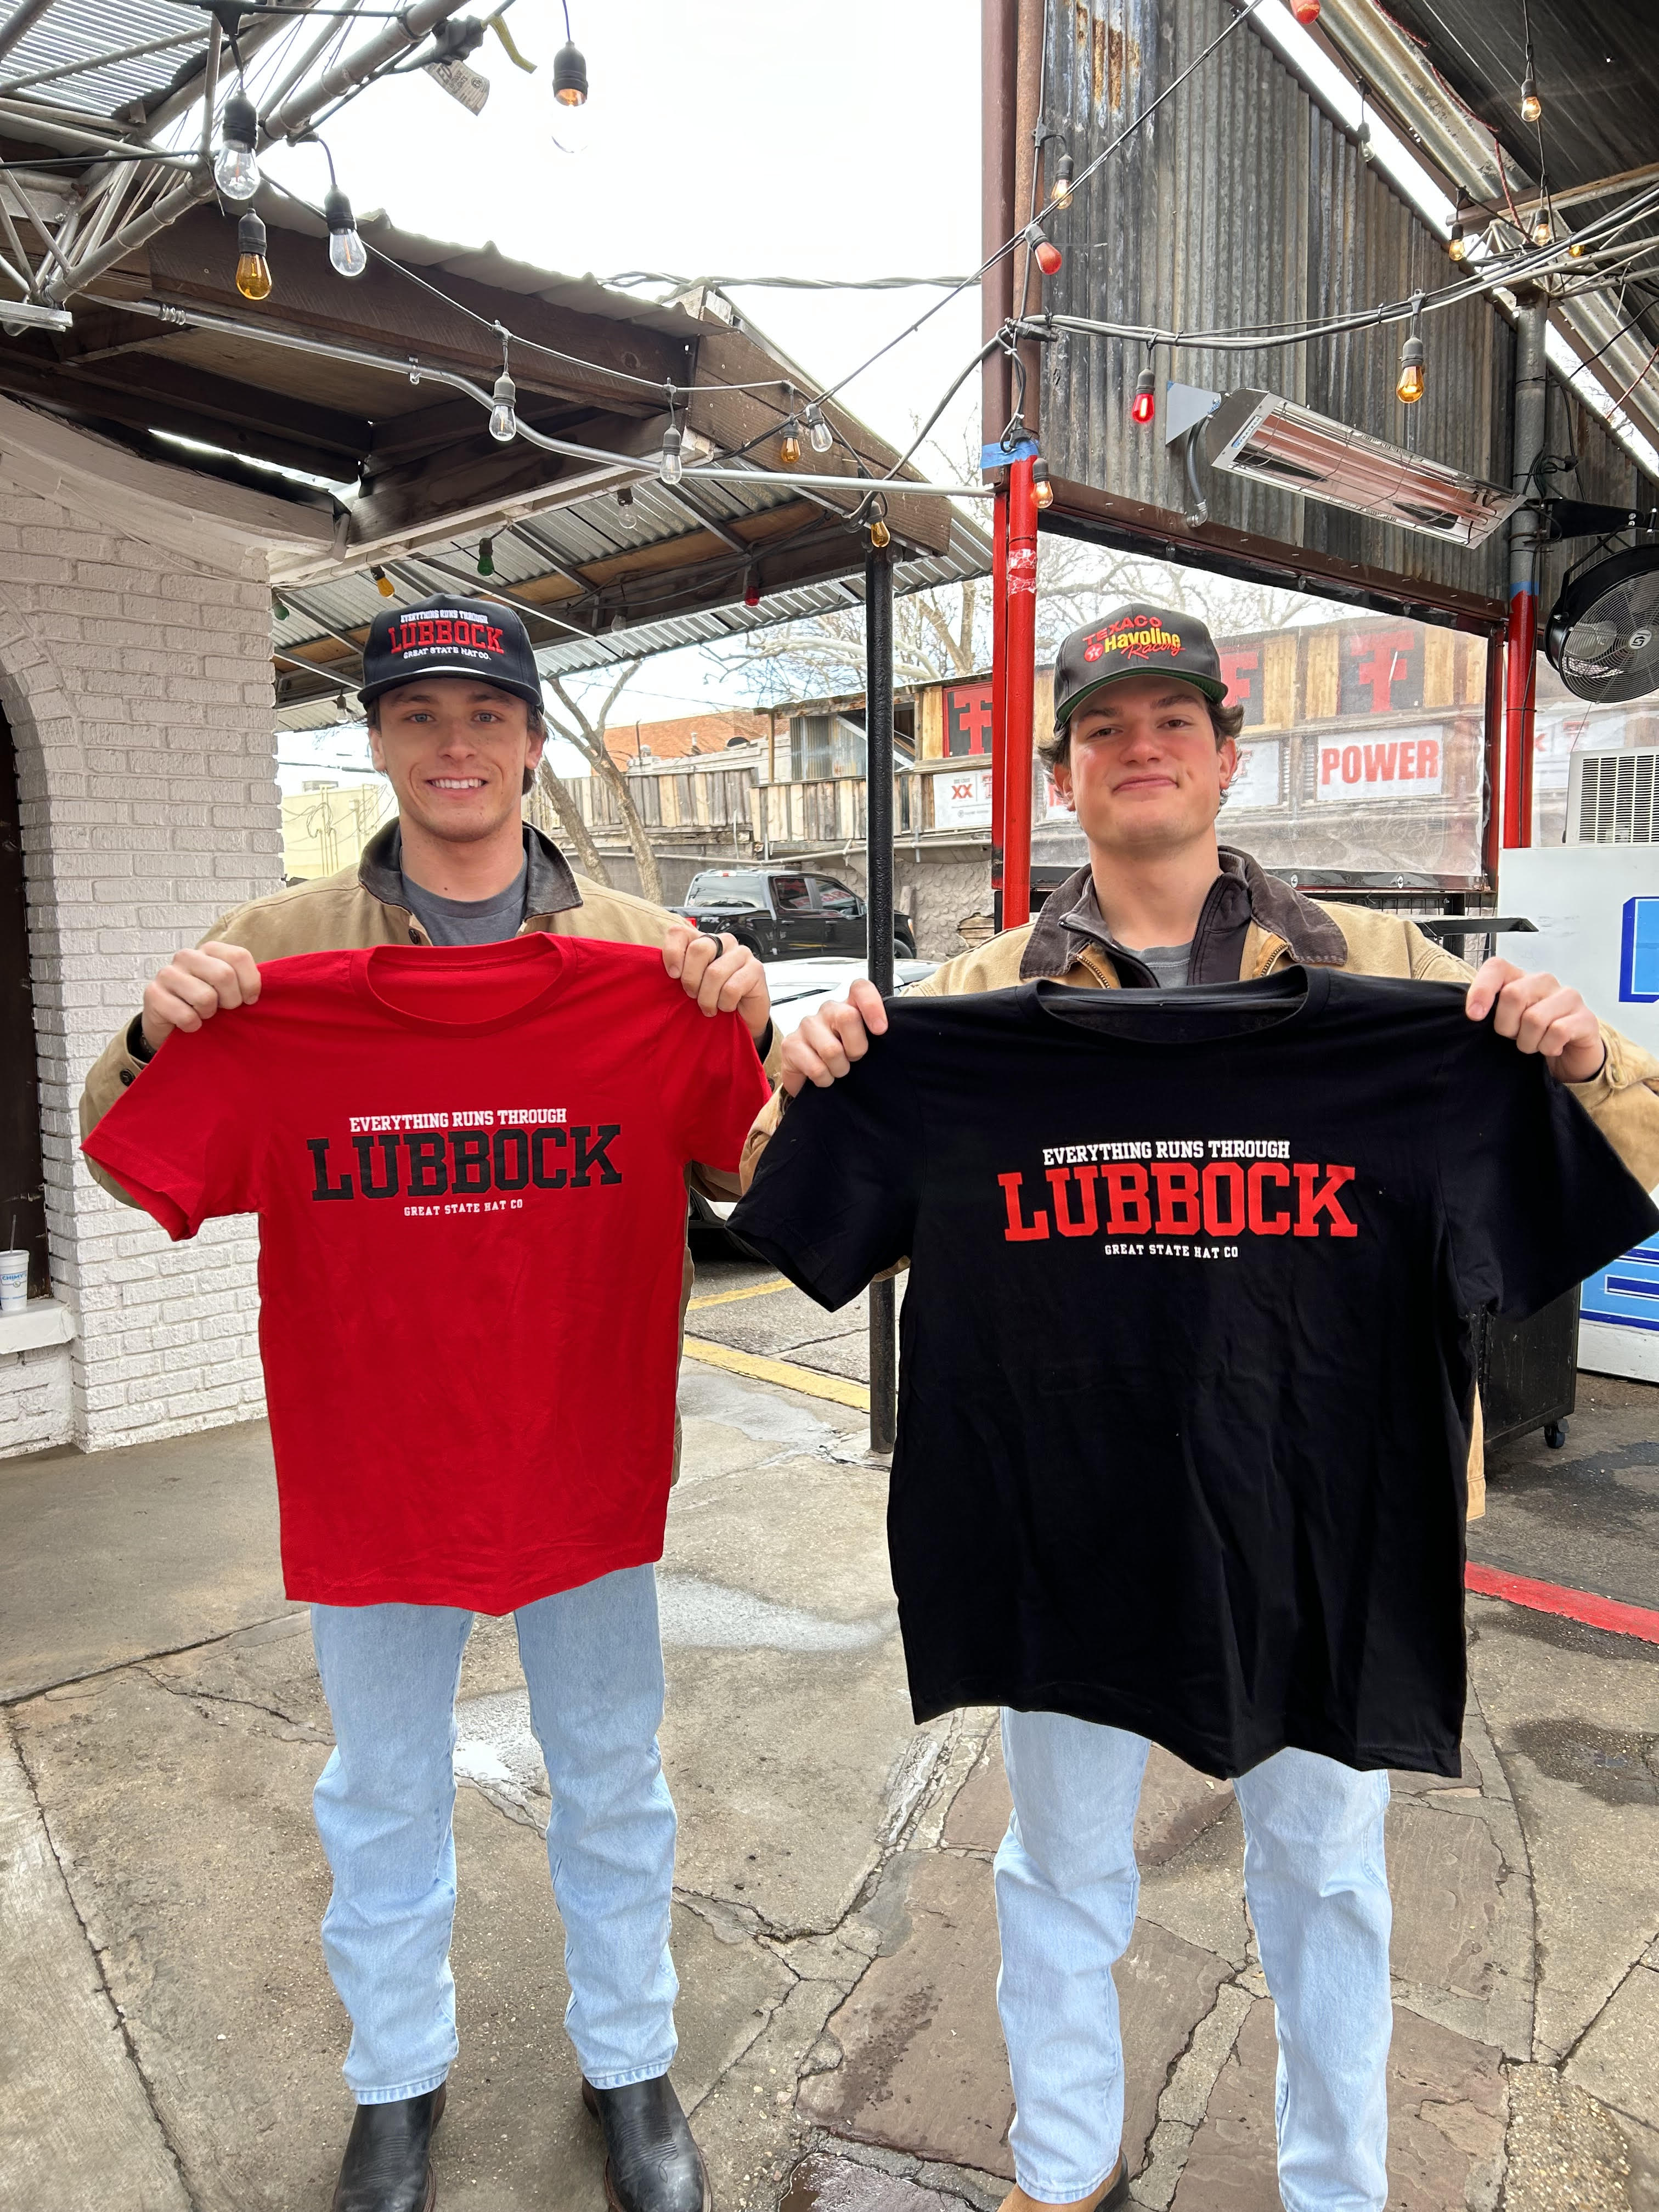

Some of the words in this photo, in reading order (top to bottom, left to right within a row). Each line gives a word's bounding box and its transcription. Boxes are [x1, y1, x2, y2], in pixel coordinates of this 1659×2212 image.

[388, 620, 504, 654] LUBBOCK
[1082, 614, 1163, 646] TEXACO
[1105, 628, 1181, 653] Havoline
[404, 647, 428, 659] GREAT
[461, 647, 478, 657] HAT
[1121, 642, 1186, 661] Racing
[1322, 740, 1440, 785] POWER
[951, 783, 974, 799] XX
[349, 1113, 448, 1132] EVERYTHING
[452, 1110, 493, 1127] RUNS
[497, 1108, 567, 1125] THROUGH
[307, 1125, 622, 1201] LUBBOCK
[1042, 1142, 1152, 1165] EVERYTHING
[1155, 1141, 1204, 1159] RUNS
[1208, 1141, 1290, 1159] THROUGH
[404, 1205, 440, 1216] GREAT
[445, 1203, 479, 1215] STATE
[484, 1200, 506, 1211] HAT
[511, 1199, 523, 1209] CO
[998, 1162, 1357, 1241] LUBBOCK
[1105, 1244, 1144, 1255] GREAT
[1149, 1245, 1189, 1256] STATE
[1194, 1246, 1219, 1259] HAT
[1224, 1246, 1238, 1257] CO
